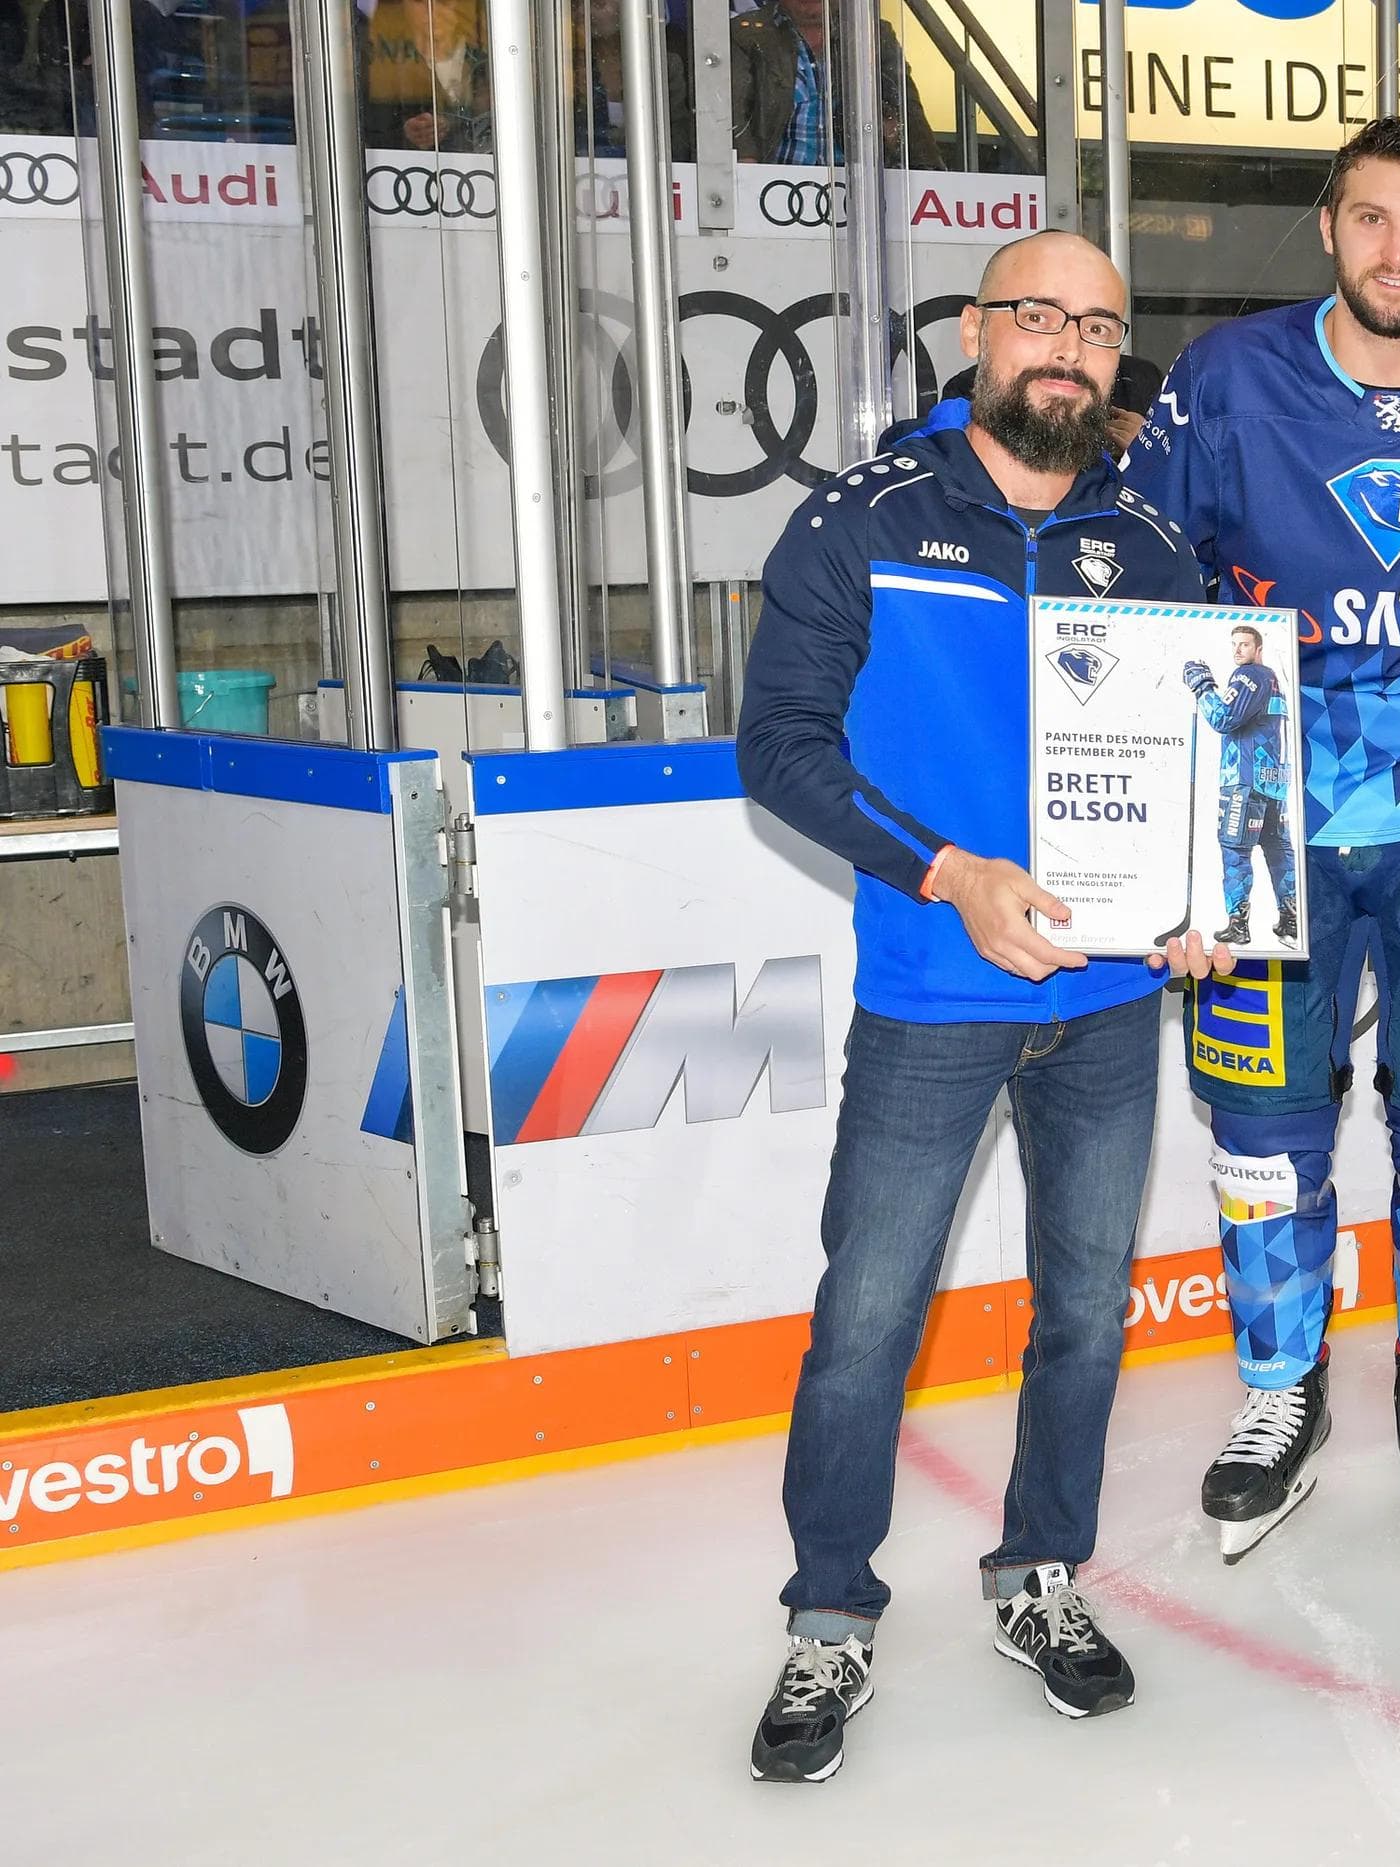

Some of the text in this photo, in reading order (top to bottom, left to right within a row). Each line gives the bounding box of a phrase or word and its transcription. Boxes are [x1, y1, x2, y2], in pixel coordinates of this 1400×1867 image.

[1082, 49, 1236, 118] EINE
[138, 164, 279, 207] Audi
[911, 190, 1038, 230] Audi
[918, 540, 970, 564] JAKO
[1080, 537, 1116, 554] ERC
[1056, 622, 1108, 637] ERC
[1045, 732, 1185, 747] PANTHER DES MONATS
[1045, 746, 1146, 759] SEPTEMBER 2019
[1047, 772, 1132, 795] BRETT
[1047, 799, 1147, 823] OLSON
[188, 911, 295, 999] BMW
[1197, 1041, 1275, 1075] EDEKA
